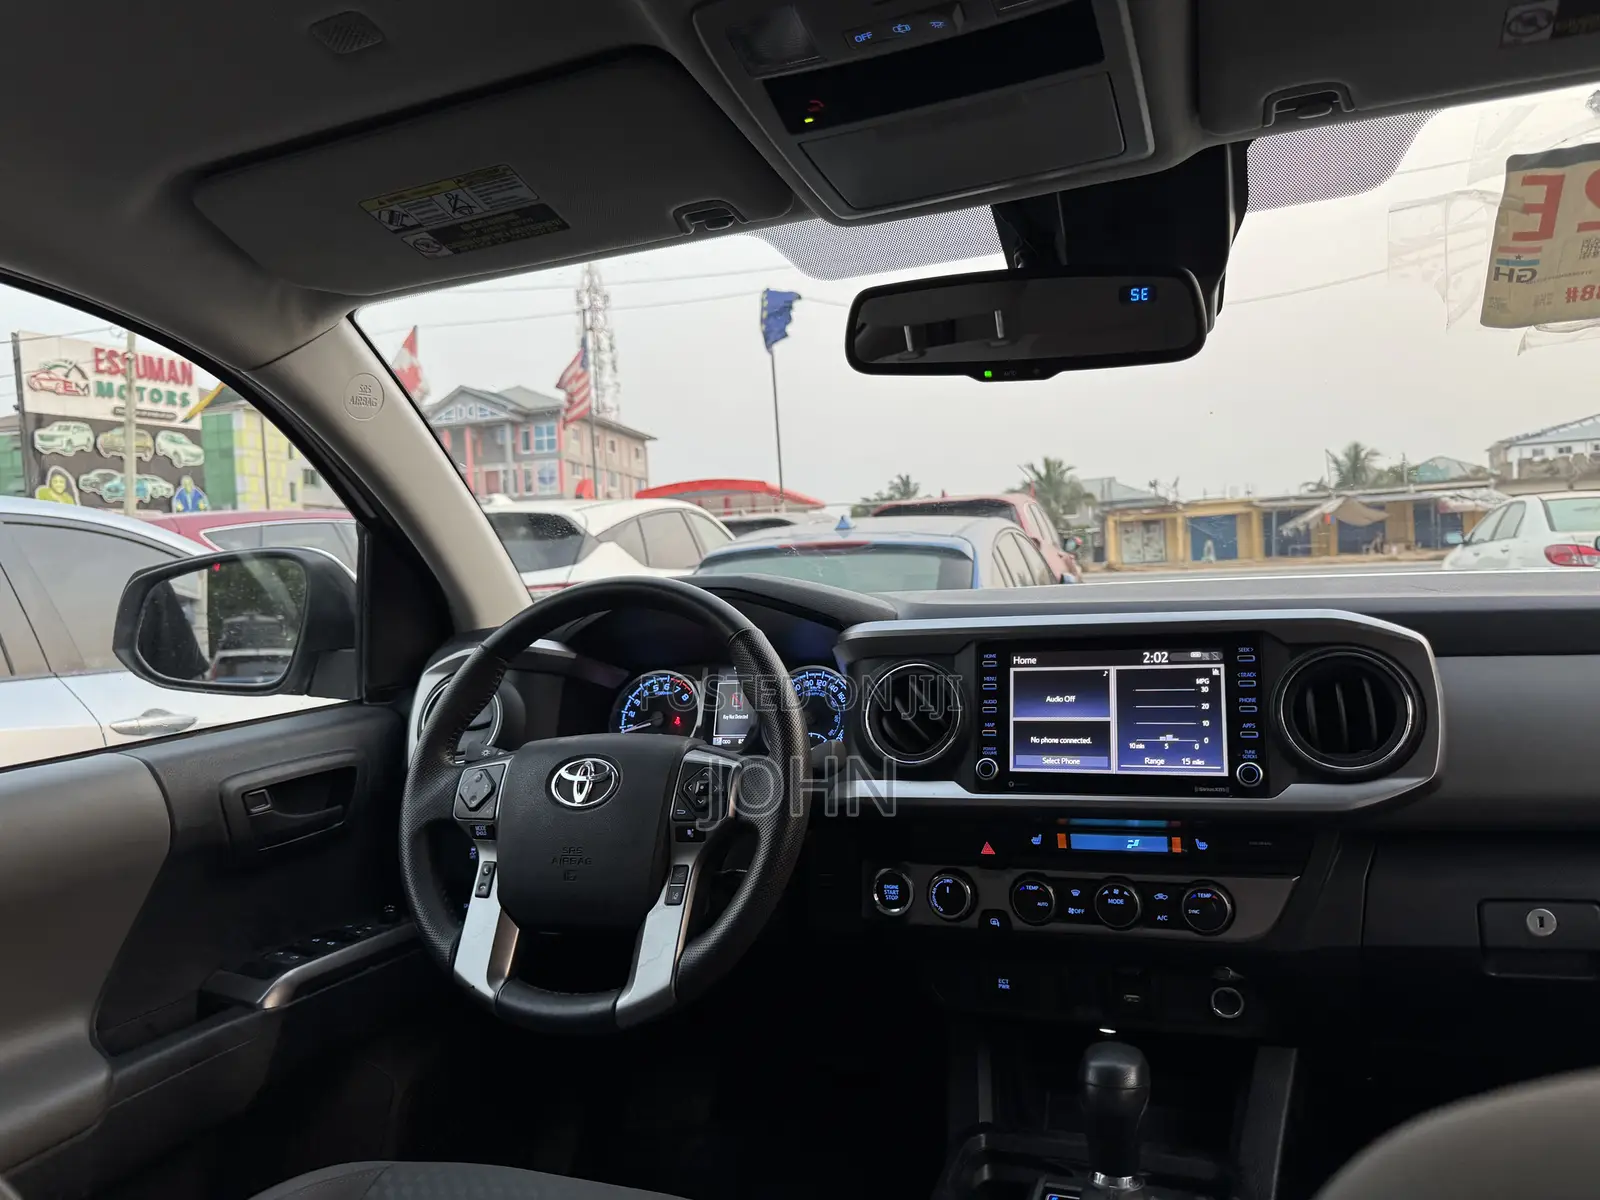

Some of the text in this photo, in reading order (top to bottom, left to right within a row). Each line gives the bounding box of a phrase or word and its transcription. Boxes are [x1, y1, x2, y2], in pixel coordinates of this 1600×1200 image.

[855, 31, 873, 43] OFF
[1130, 287, 1149, 302] SE
[1013, 656, 1037, 665] Home
[1142, 651, 1169, 663] 2:02
[652, 684, 659, 692] 5
[663, 683, 670, 691] 6
[674, 685, 681, 693] 7
[681, 693, 690, 702] 8
[1045, 695, 1076, 703] Audio Off
[633, 699, 641, 707] 3
[628, 710, 636, 718] 2
[1030, 736, 1093, 745] No phone connected.
[1042, 757, 1081, 765] Select Phone
[1144, 757, 1165, 766] Range
[562, 846, 583, 854] SRS
[551, 856, 593, 866] AIRBAG
